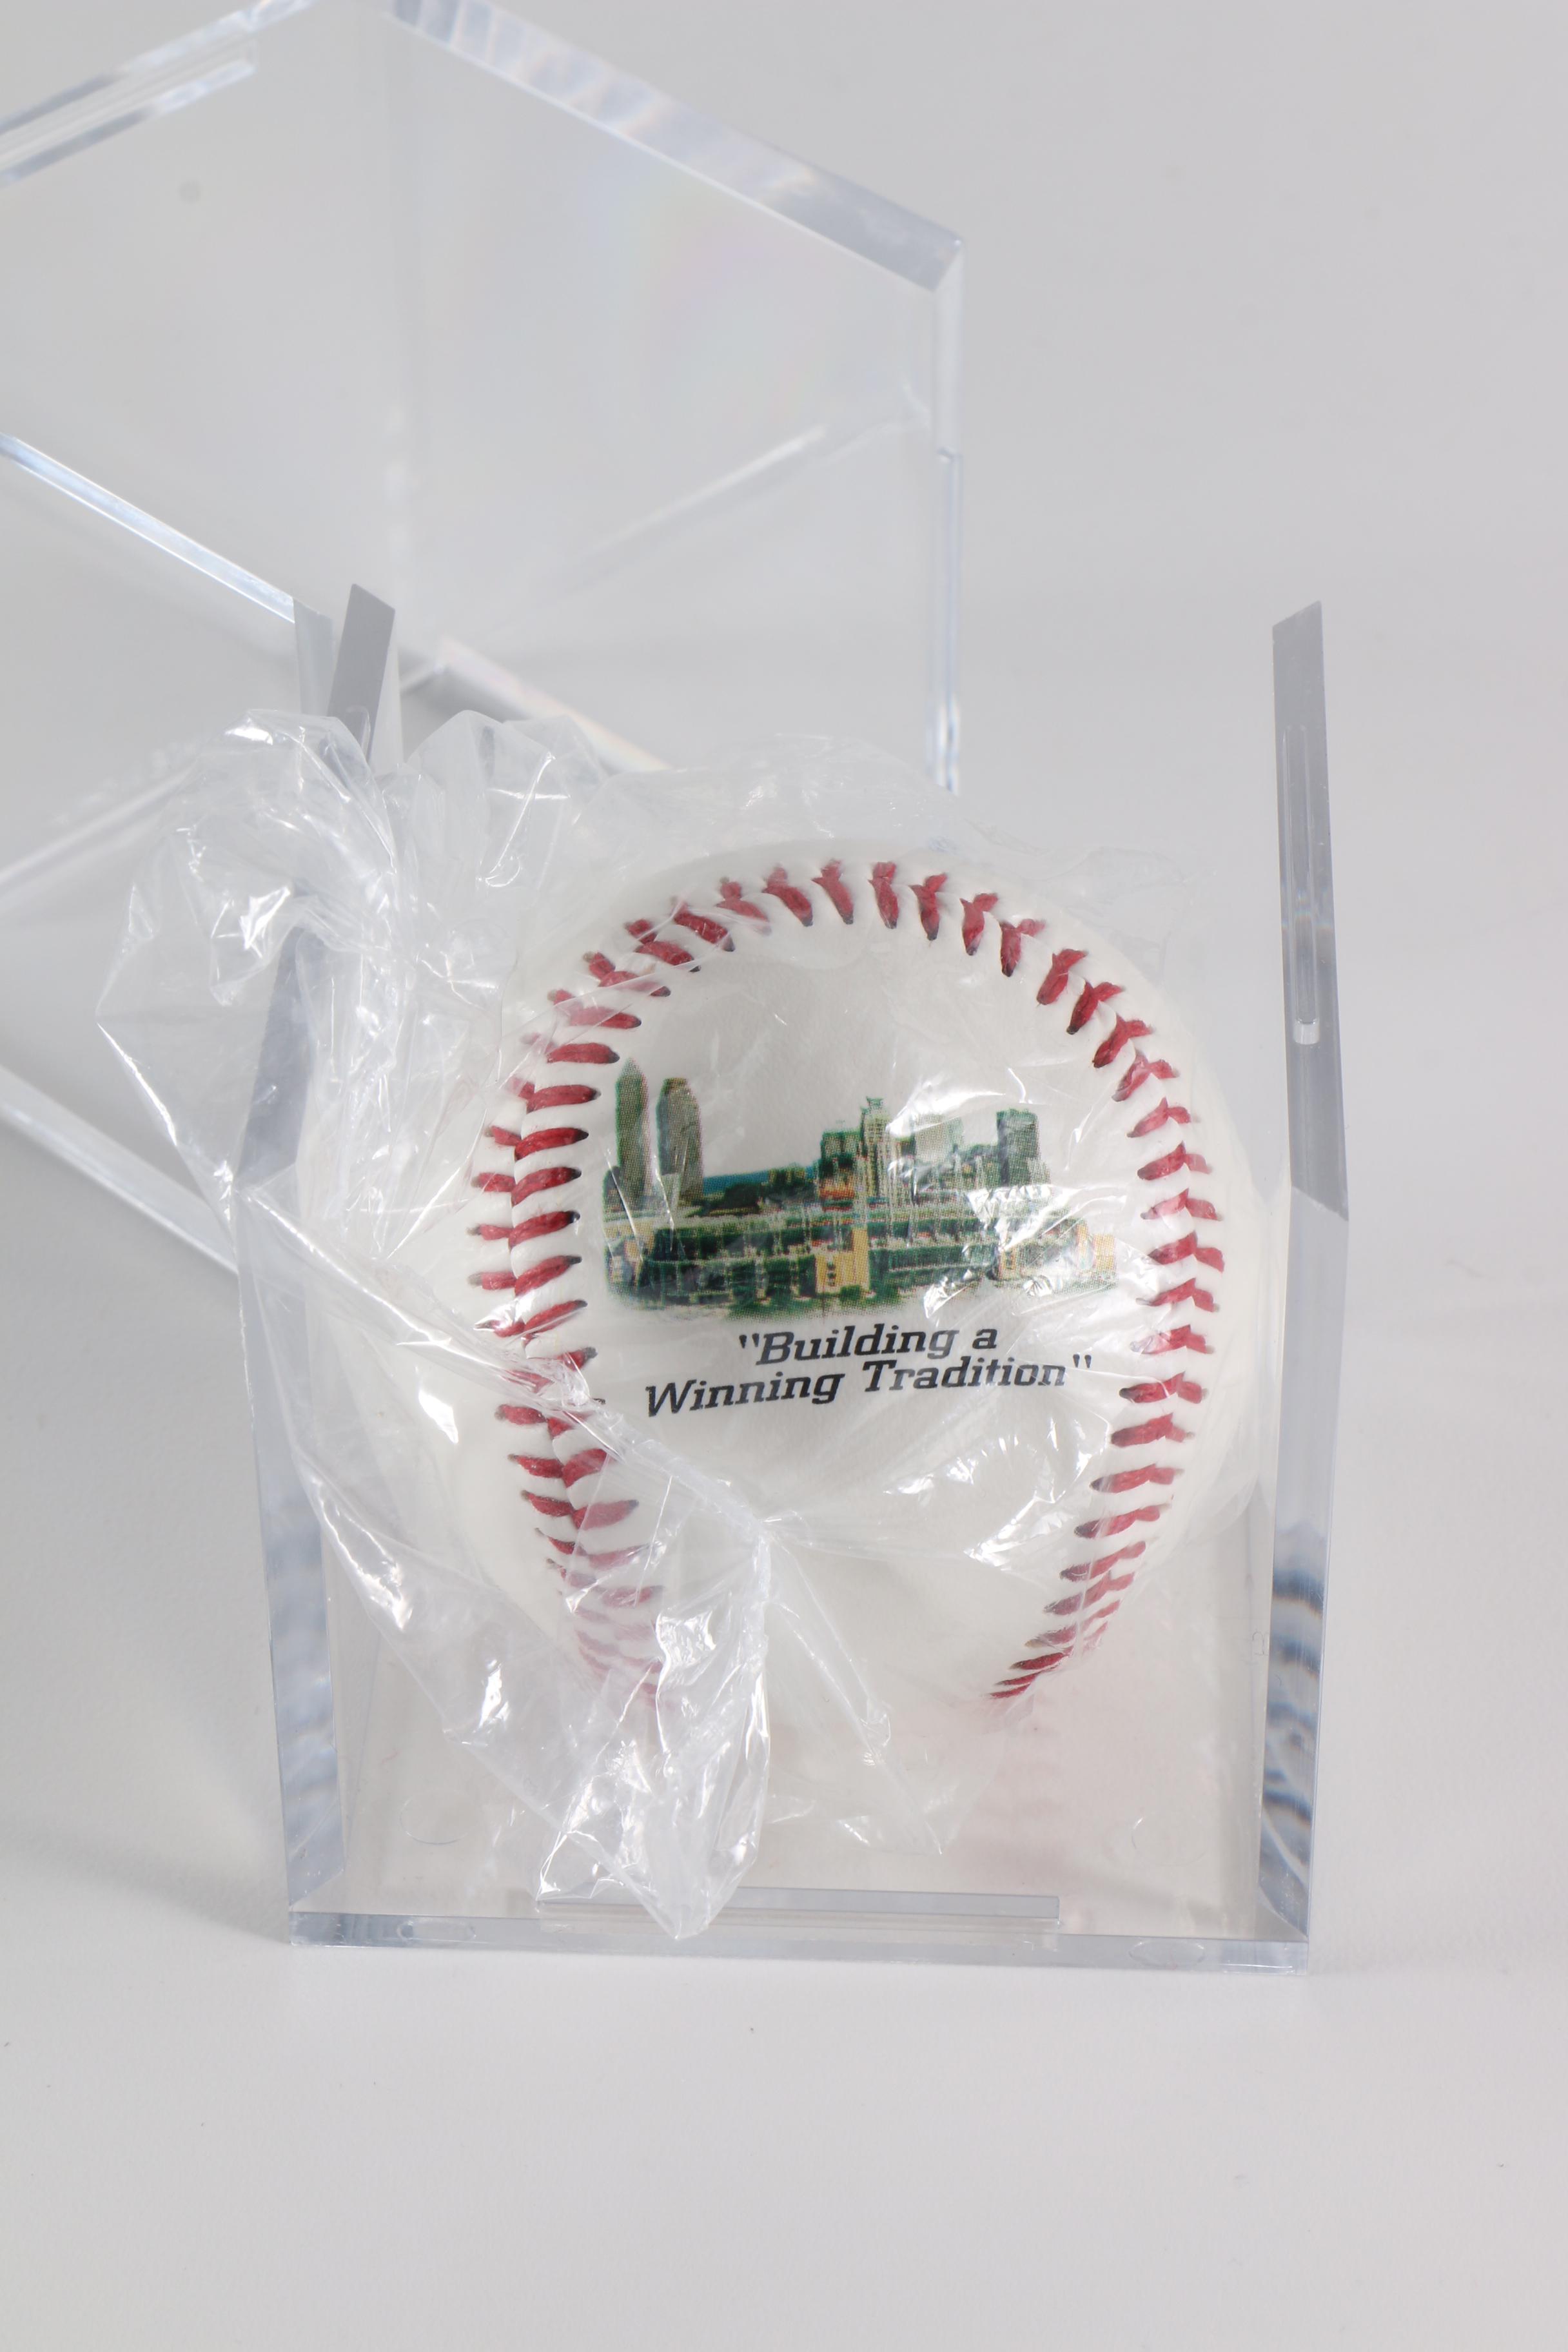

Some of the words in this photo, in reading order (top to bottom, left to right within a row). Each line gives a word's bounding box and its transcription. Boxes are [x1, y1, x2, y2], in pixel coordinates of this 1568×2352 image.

[738, 1323, 959, 1366] "Building
[972, 1328, 998, 1349] a
[645, 1371, 846, 1417] Winning
[862, 1354, 1092, 1392] Tradition"
